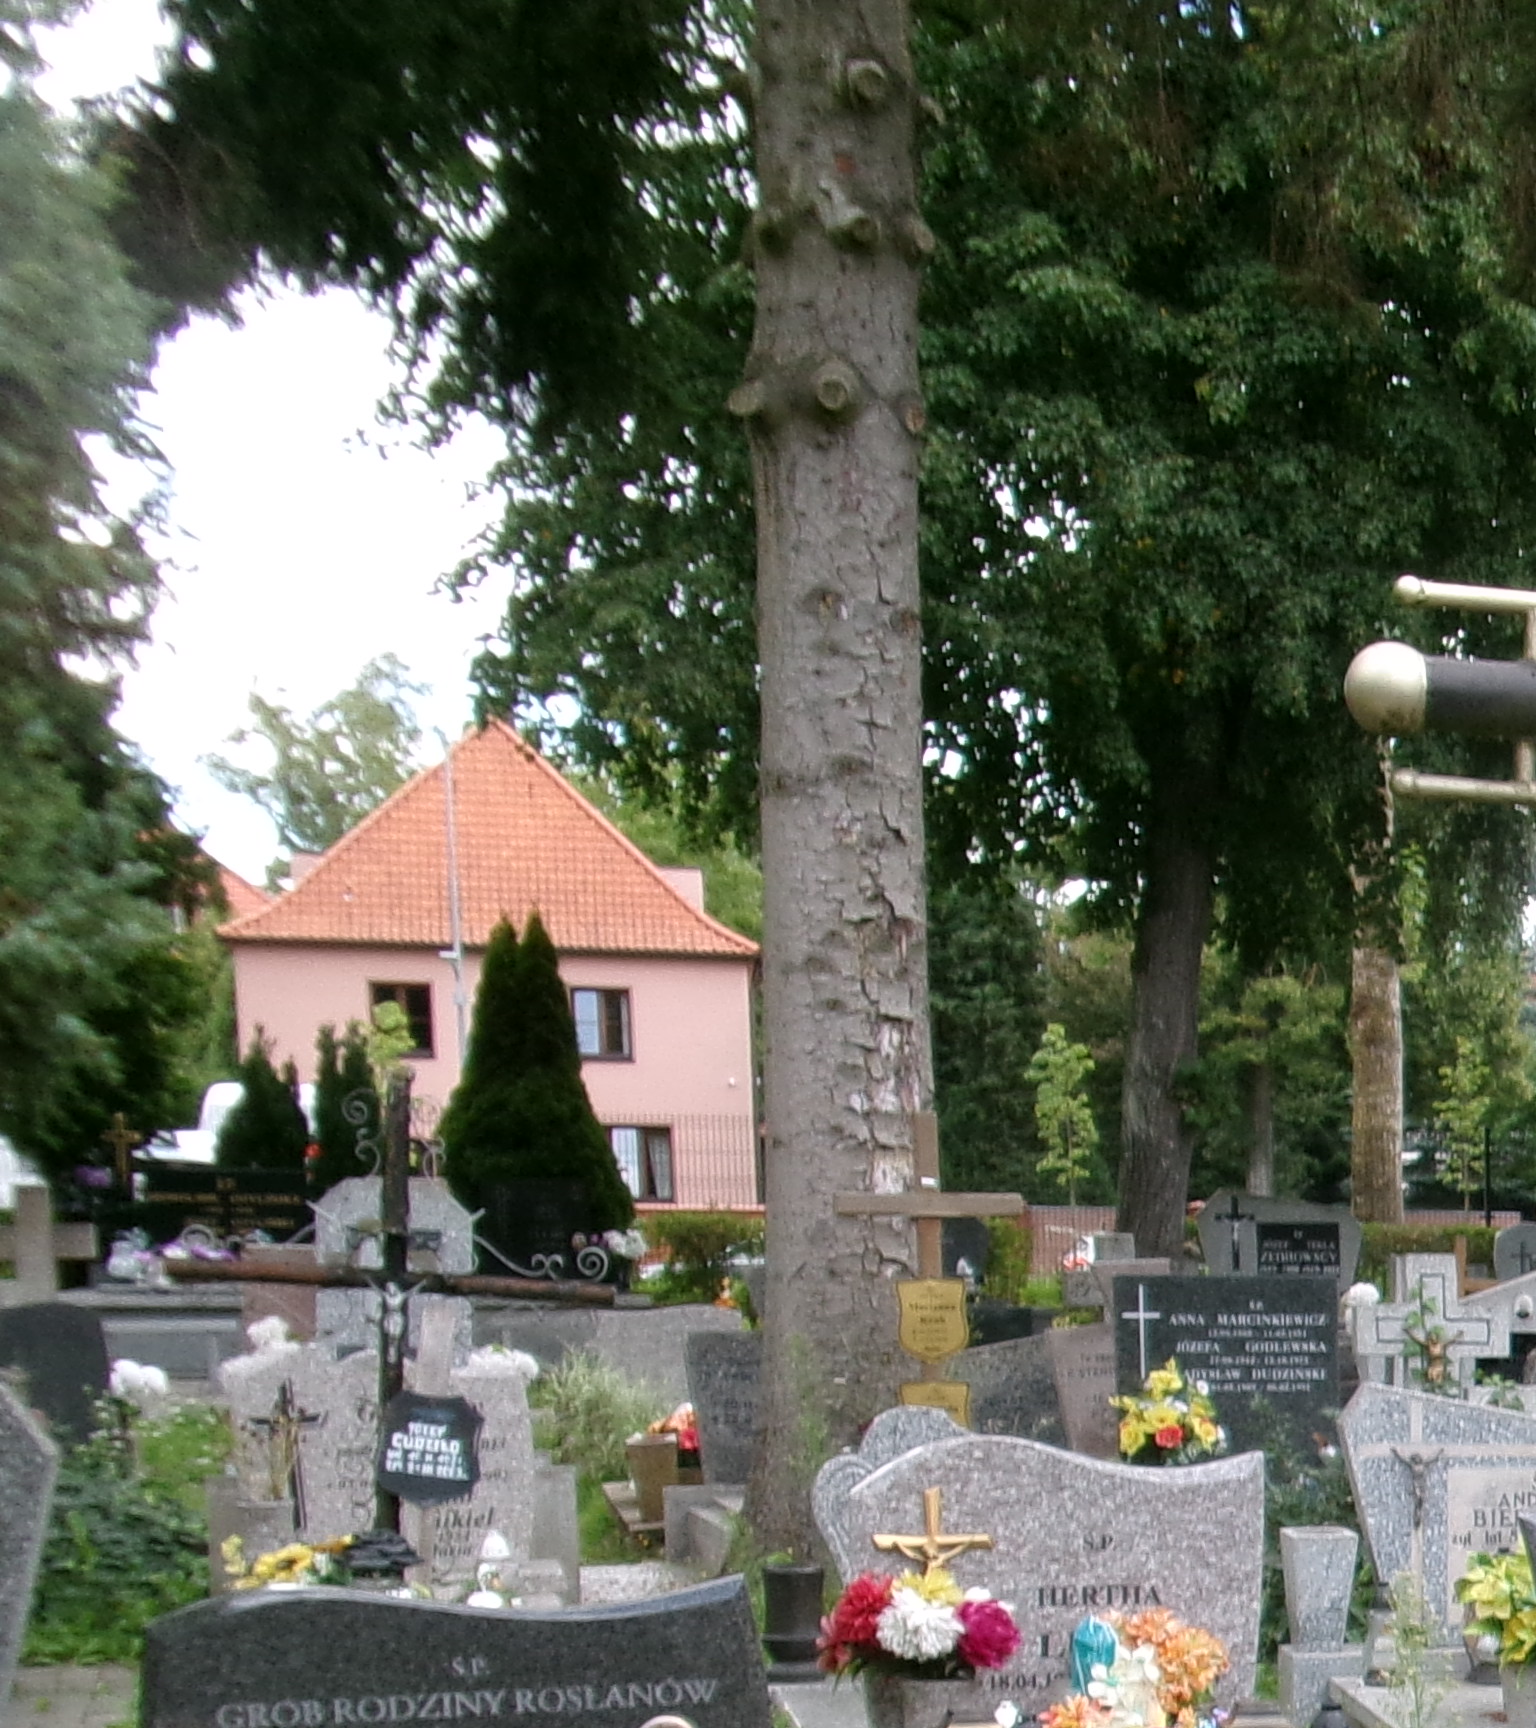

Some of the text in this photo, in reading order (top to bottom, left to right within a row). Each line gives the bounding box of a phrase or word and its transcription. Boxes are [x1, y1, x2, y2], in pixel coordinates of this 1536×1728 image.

[1169, 1313, 1327, 1326] ANNA MARCINKIEWICZ
[1245, 1340, 1327, 1353] GODLEWSKA
[1038, 1585, 1162, 1607] HERTHA
[334, 1690, 505, 1725] RODZINY
